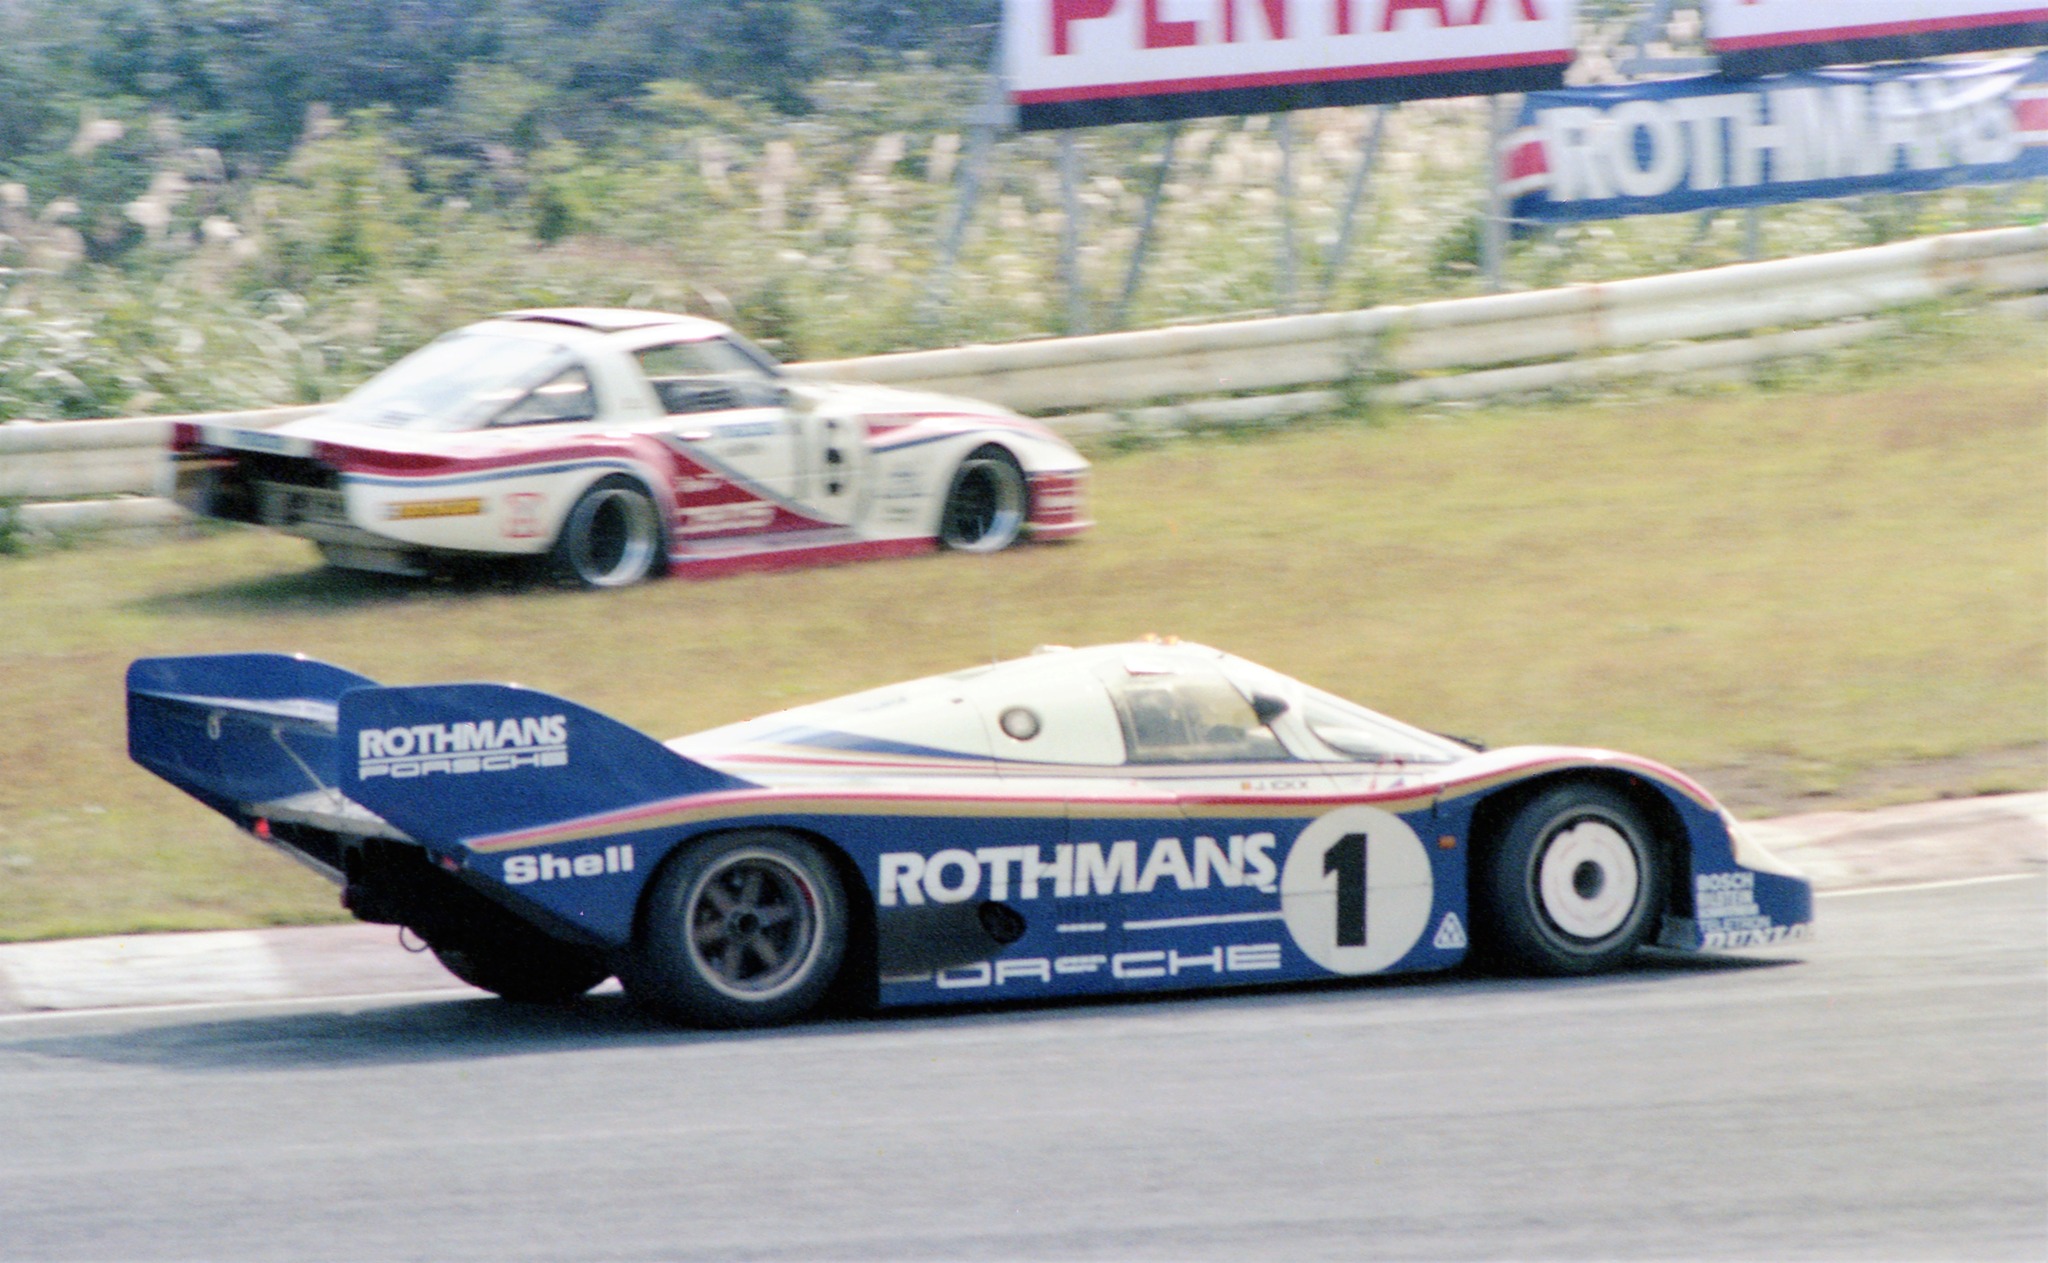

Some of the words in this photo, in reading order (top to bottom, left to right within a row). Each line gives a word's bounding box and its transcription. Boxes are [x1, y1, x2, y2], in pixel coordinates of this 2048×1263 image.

[1049, 0, 1542, 56] PEN
[359, 715, 568, 759] ROTHMANS
[359, 749, 569, 781] PORSCHE
[503, 844, 634, 885] Shell
[879, 832, 1277, 907] ROTHMANS
[1323, 833, 1368, 947] 1
